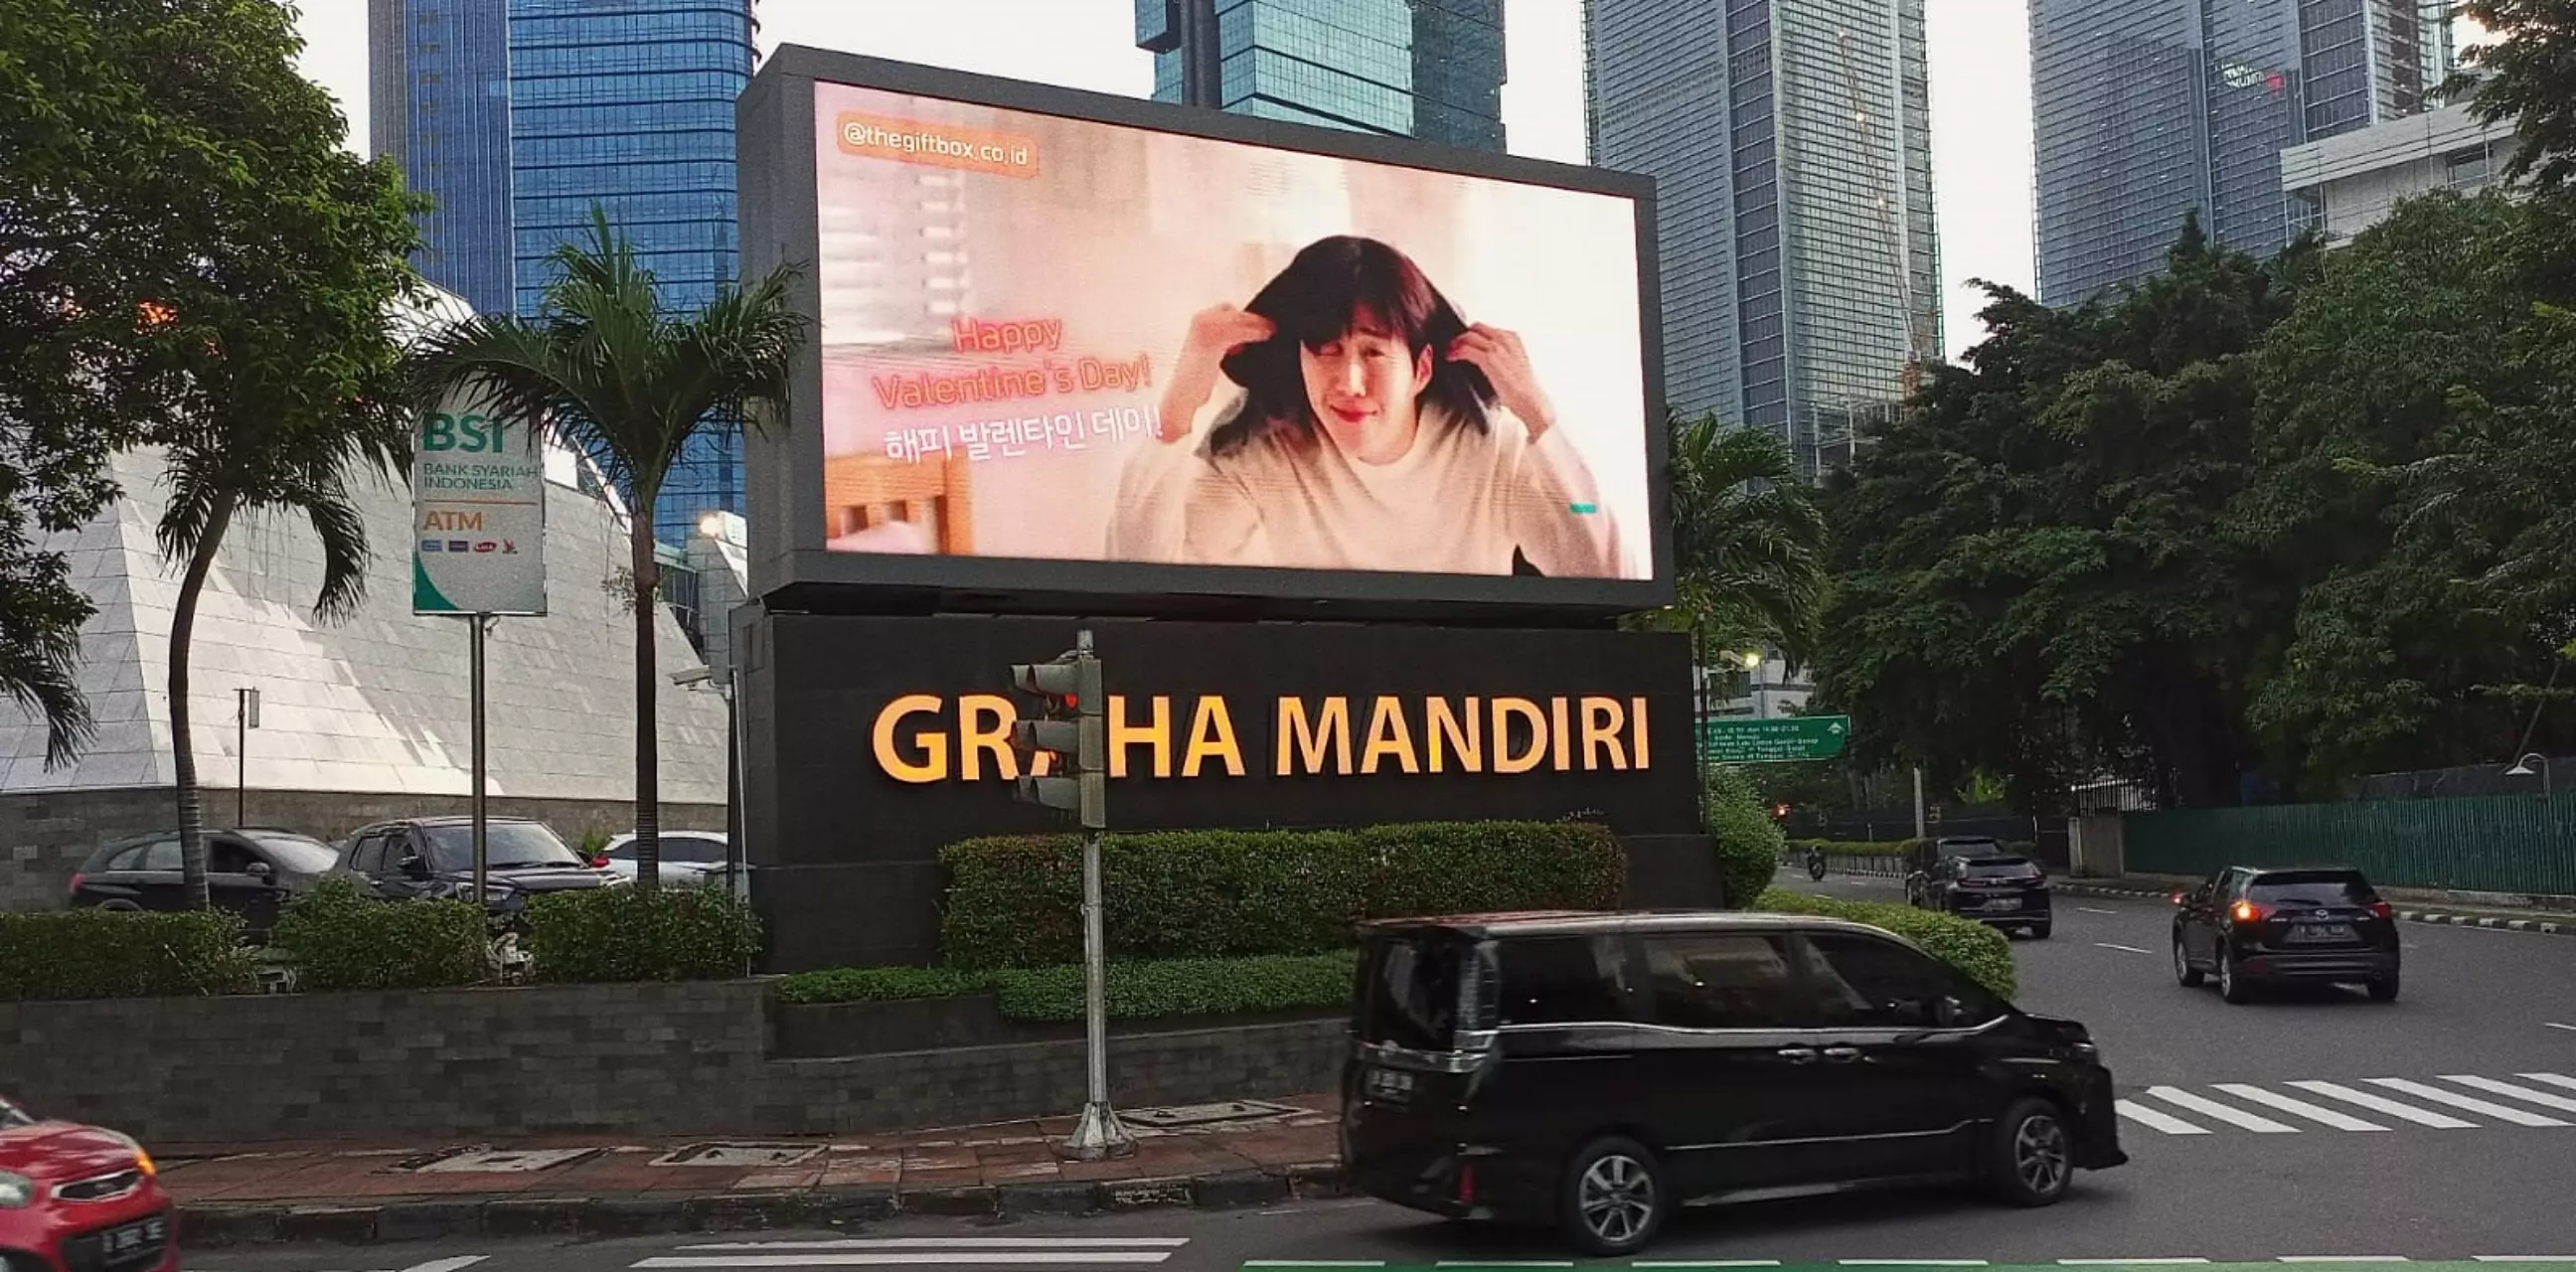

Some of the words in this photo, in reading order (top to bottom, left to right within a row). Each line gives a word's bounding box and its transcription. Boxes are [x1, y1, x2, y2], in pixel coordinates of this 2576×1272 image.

[843, 121, 1028, 166] @thegiftbox.co.id
[952, 318, 1062, 353] Happy
[875, 362, 1072, 410] Valentine's
[1079, 354, 1152, 396] Day!
[422, 412, 503, 453] BSI
[884, 428, 951, 465] 해피
[959, 412, 1084, 461] 발렌타인
[1091, 405, 1163, 445] 데이!
[424, 463, 469, 477] BANK
[471, 464, 538, 478] SYARIAH
[424, 477, 512, 491] INDONESIA
[423, 511, 483, 532] ATM
[872, 694, 1246, 783] GRHA
[1276, 695, 1651, 778] MANDIRI
